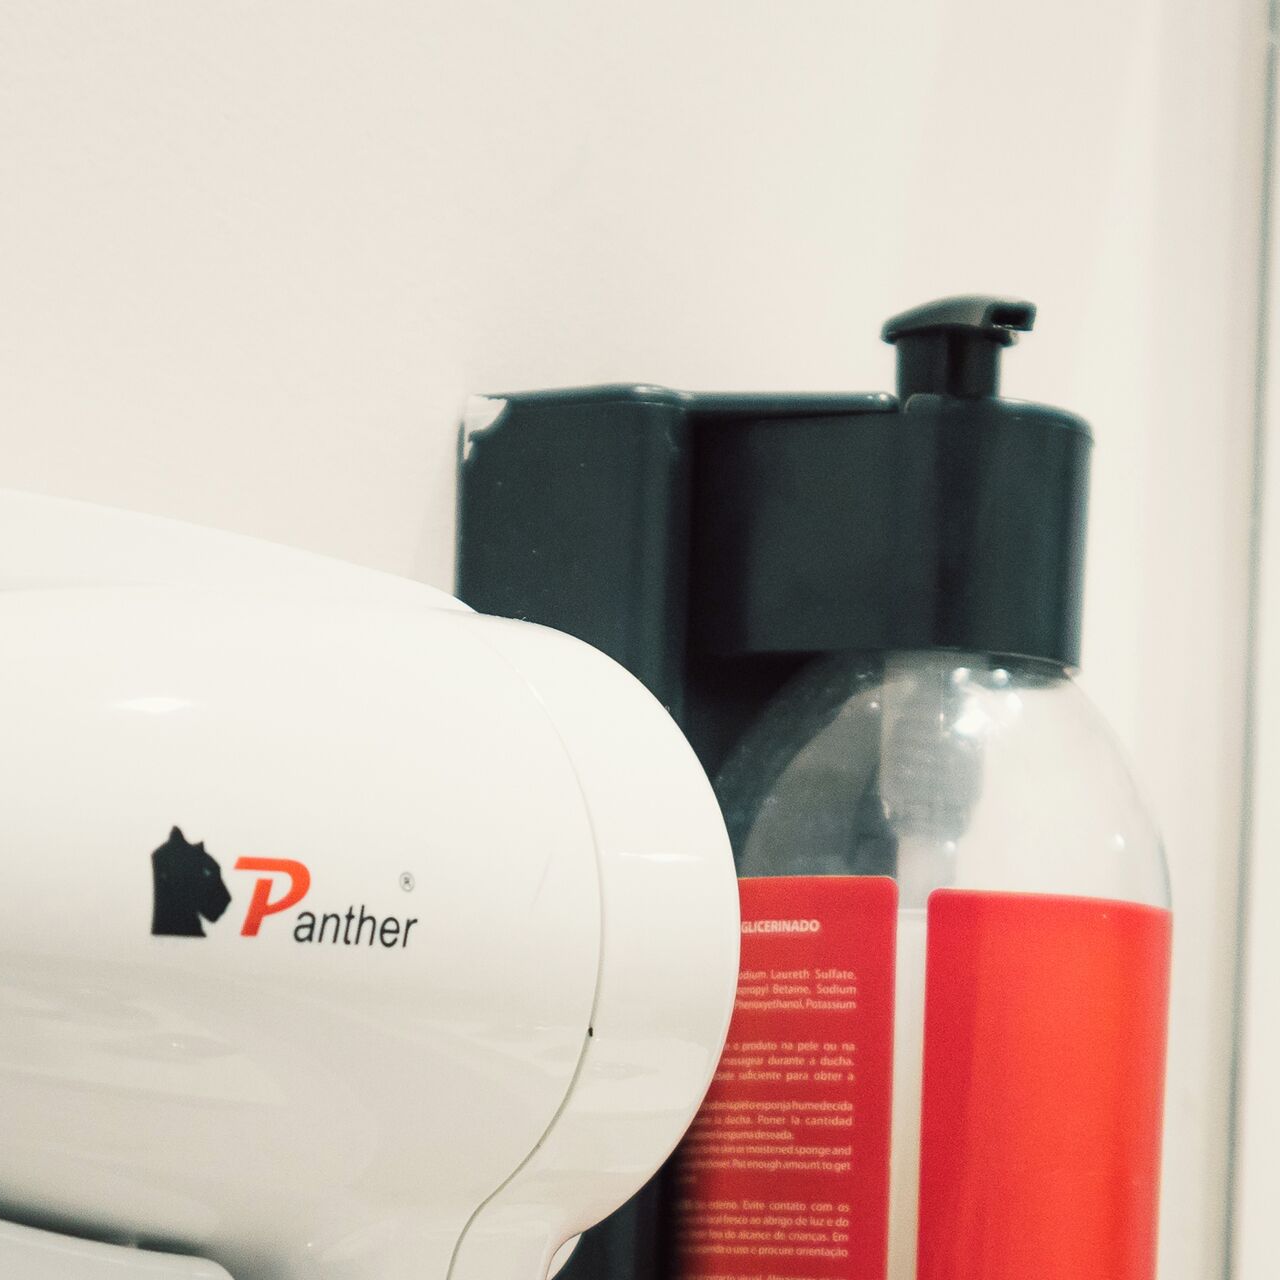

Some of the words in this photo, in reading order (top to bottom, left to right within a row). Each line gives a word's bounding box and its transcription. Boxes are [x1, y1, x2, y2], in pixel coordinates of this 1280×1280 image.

[233, 856, 418, 948] Panther
[770, 969, 810, 980] Laureth
[816, 983, 857, 995] Sodium
[804, 999, 857, 1010] Potassium
[742, 1041, 778, 1052] produto
[781, 1042, 794, 1050] na
[797, 1042, 819, 1052] pele
[842, 1043, 856, 1051] na
[805, 1116, 852, 1127] cantidad
[832, 1147, 852, 1156] and
[823, 1161, 831, 1170] to
[810, 1202, 832, 1212] com
[836, 1218, 849, 1228] do
[832, 1232, 848, 1242] Em
